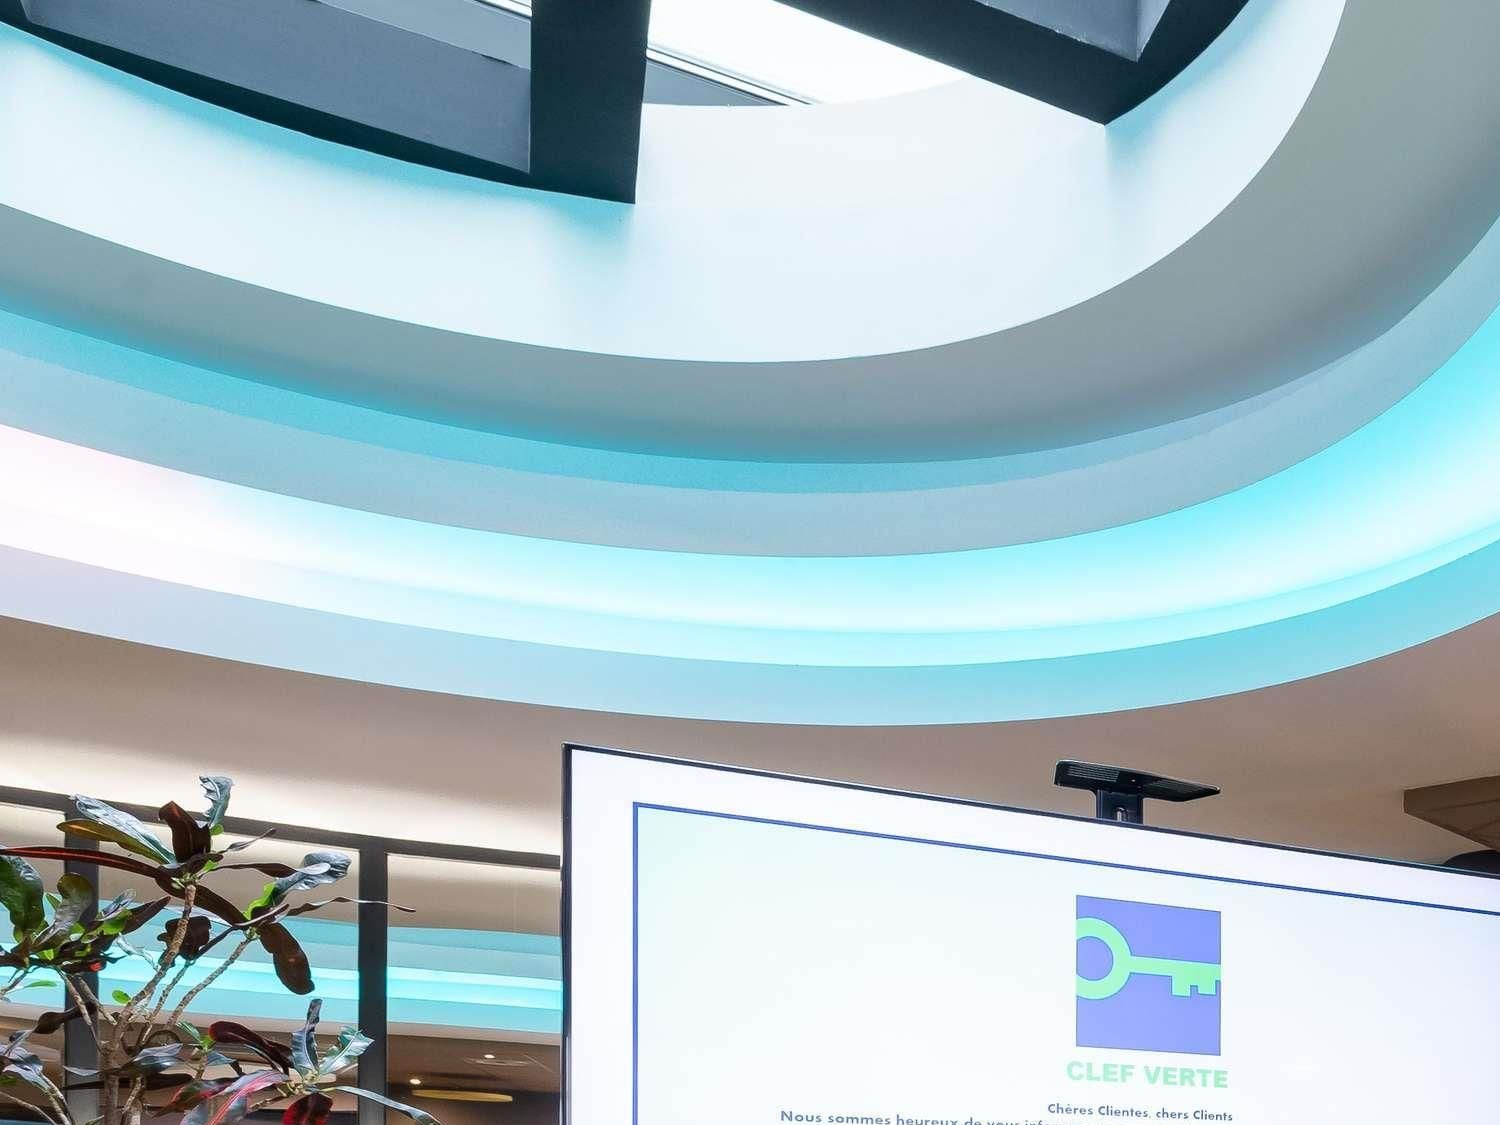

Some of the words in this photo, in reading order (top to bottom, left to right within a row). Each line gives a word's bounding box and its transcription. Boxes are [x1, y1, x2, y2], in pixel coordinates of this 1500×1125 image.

[1066, 1060, 1135, 1084] CLEF
[1143, 1065, 1229, 1089] VERTE
[780, 1110, 823, 1123] Nous
[827, 1114, 892, 1125] sommes
[1155, 1106, 1190, 1120] chers
[1192, 1108, 1233, 1122] Clients
